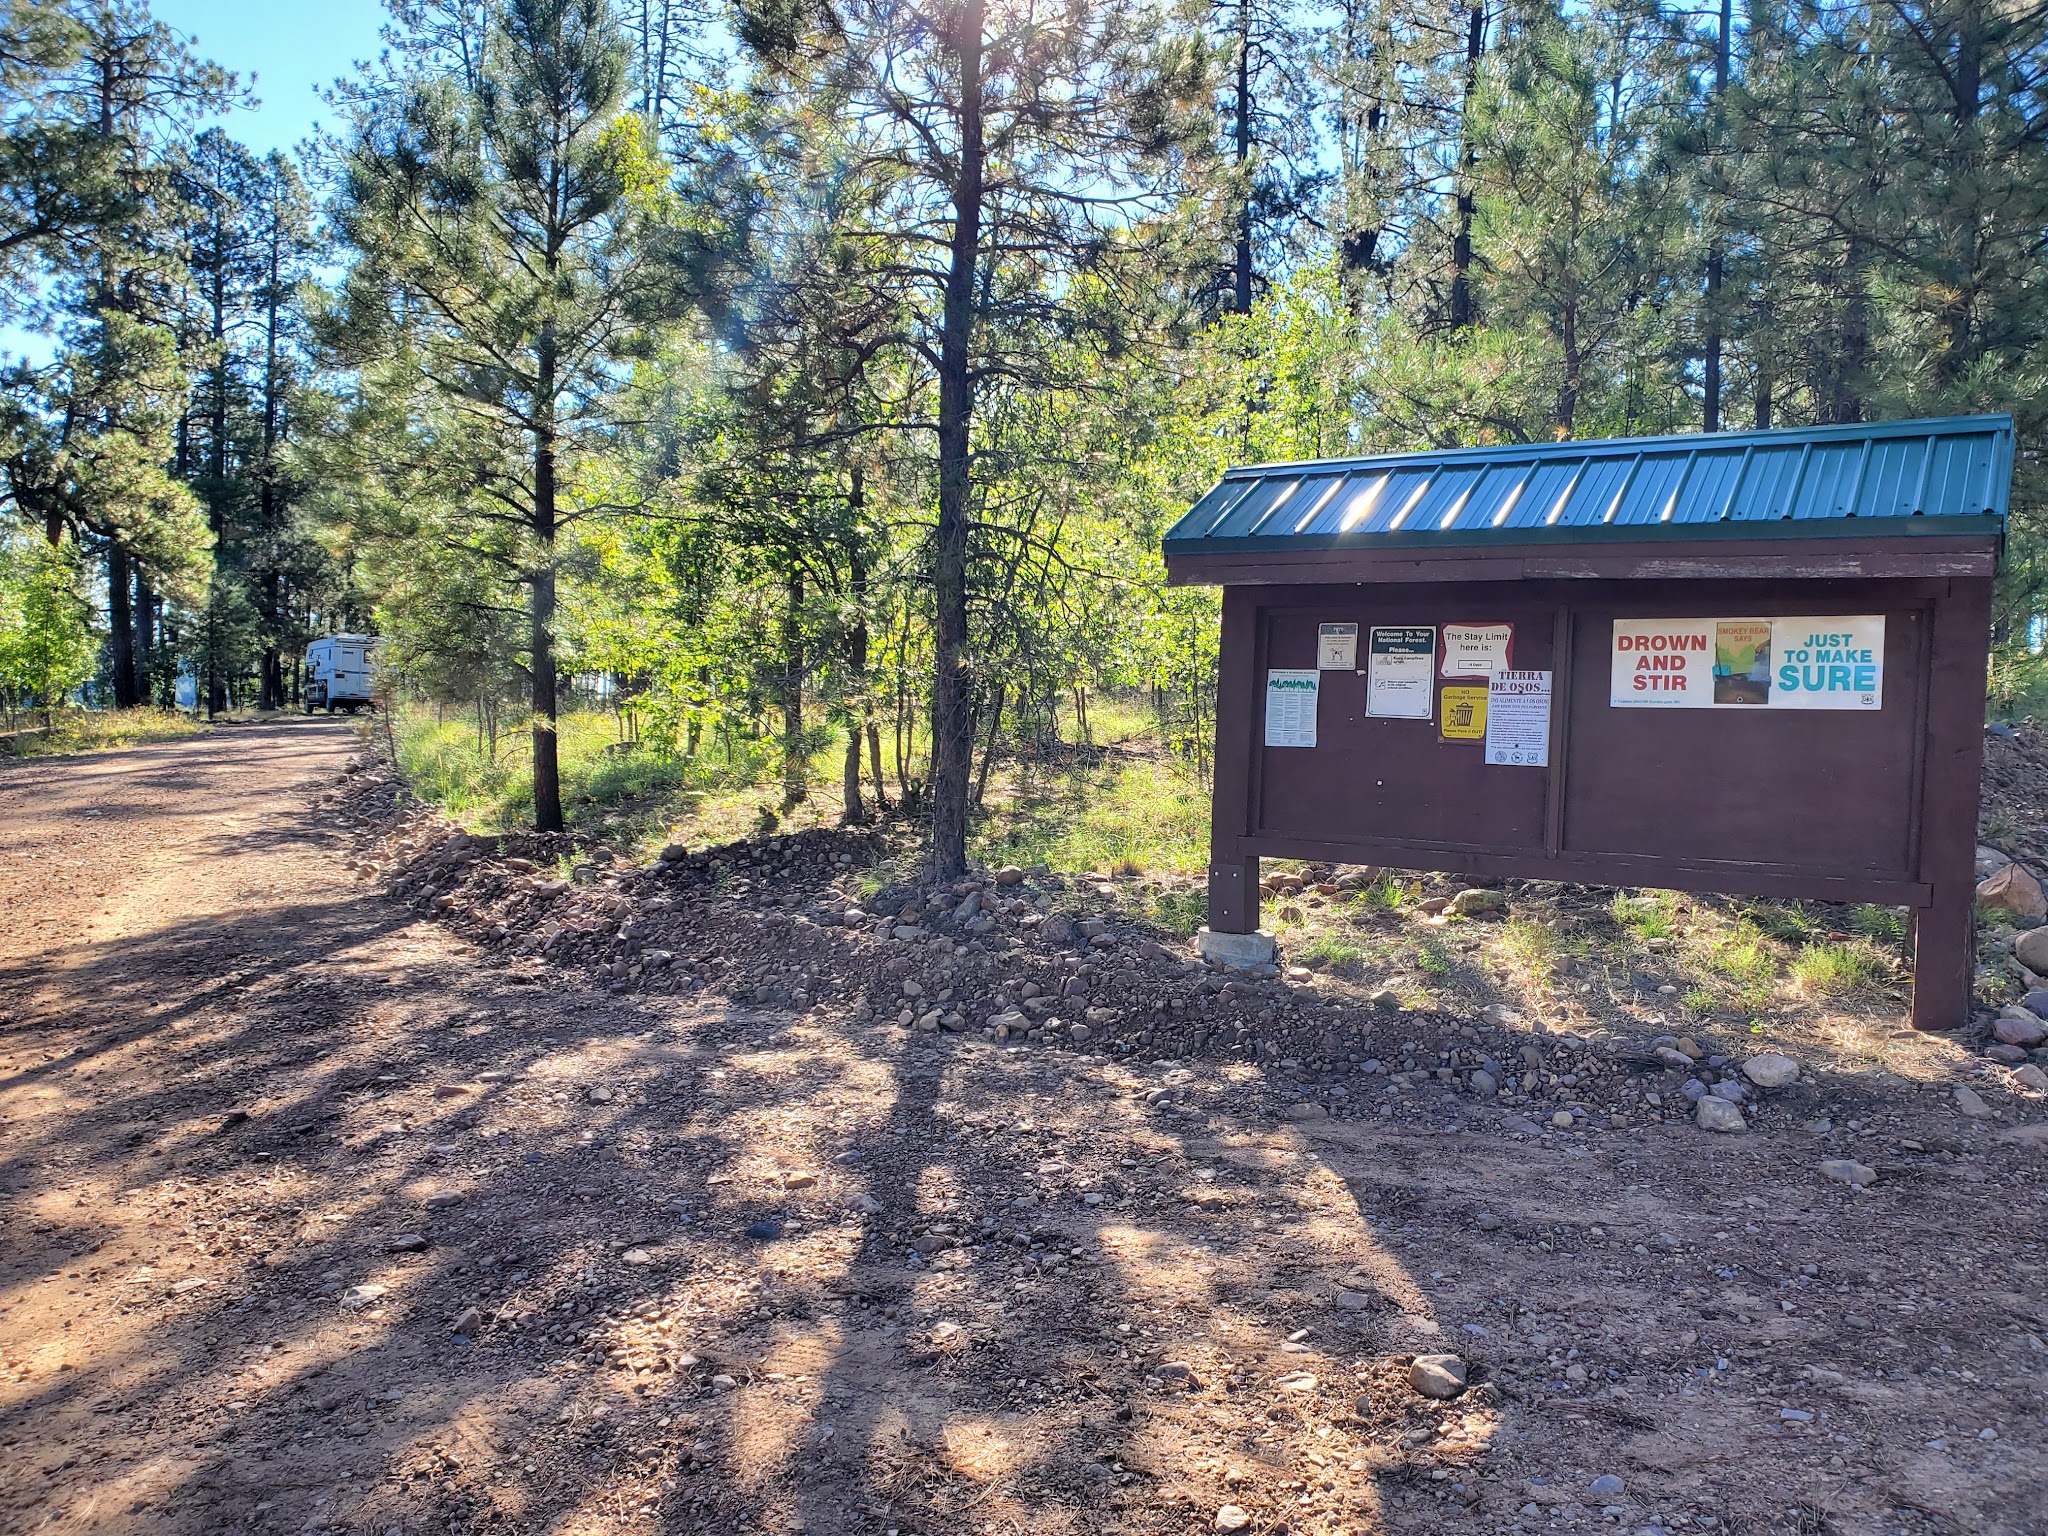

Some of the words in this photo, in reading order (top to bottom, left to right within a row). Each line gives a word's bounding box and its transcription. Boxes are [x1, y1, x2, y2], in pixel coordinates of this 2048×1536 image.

[1464, 633, 1482, 642] Stay
[1618, 635, 1706, 651] DROWN
[1804, 634, 1853, 647] JUST
[1636, 656, 1686, 670] AND
[1784, 650, 1809, 663] TO
[1816, 650, 1872, 663] MAKE
[1499, 672, 1543, 680] TIERRA
[1633, 675, 1687, 690] STIR
[1778, 665, 1875, 691] SURE
[1492, 683, 1506, 691] DE
[1510, 683, 1550, 692] OSOS...
